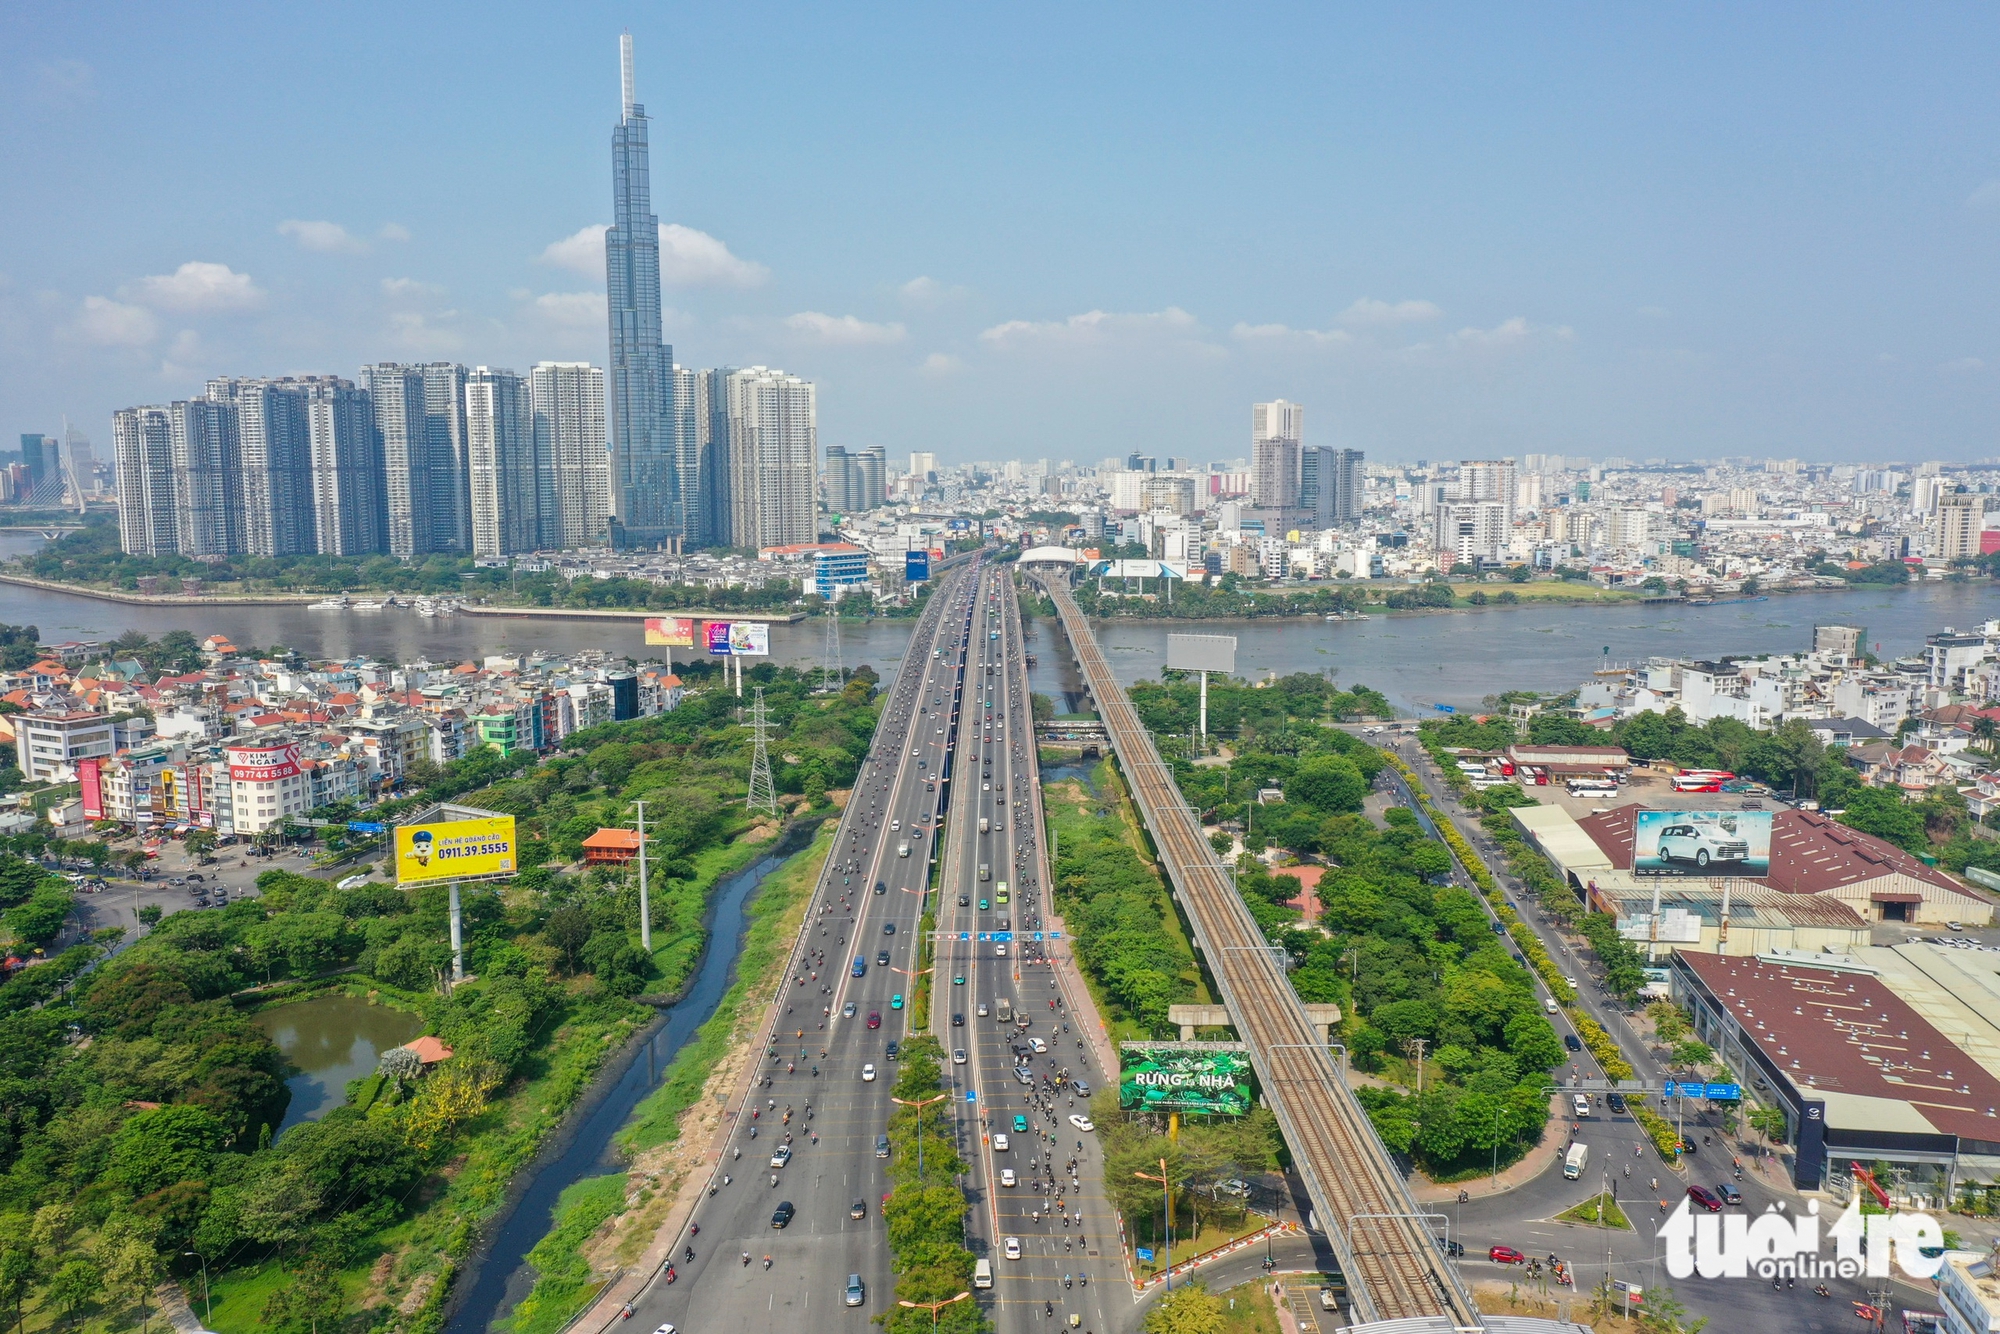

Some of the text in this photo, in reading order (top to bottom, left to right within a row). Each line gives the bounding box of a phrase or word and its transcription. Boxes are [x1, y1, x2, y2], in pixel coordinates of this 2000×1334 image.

[438, 842, 508, 859] 0911.39.5555
[1135, 1070, 1182, 1086] RỪNG
[1199, 1072, 1235, 1088] NHÀ
